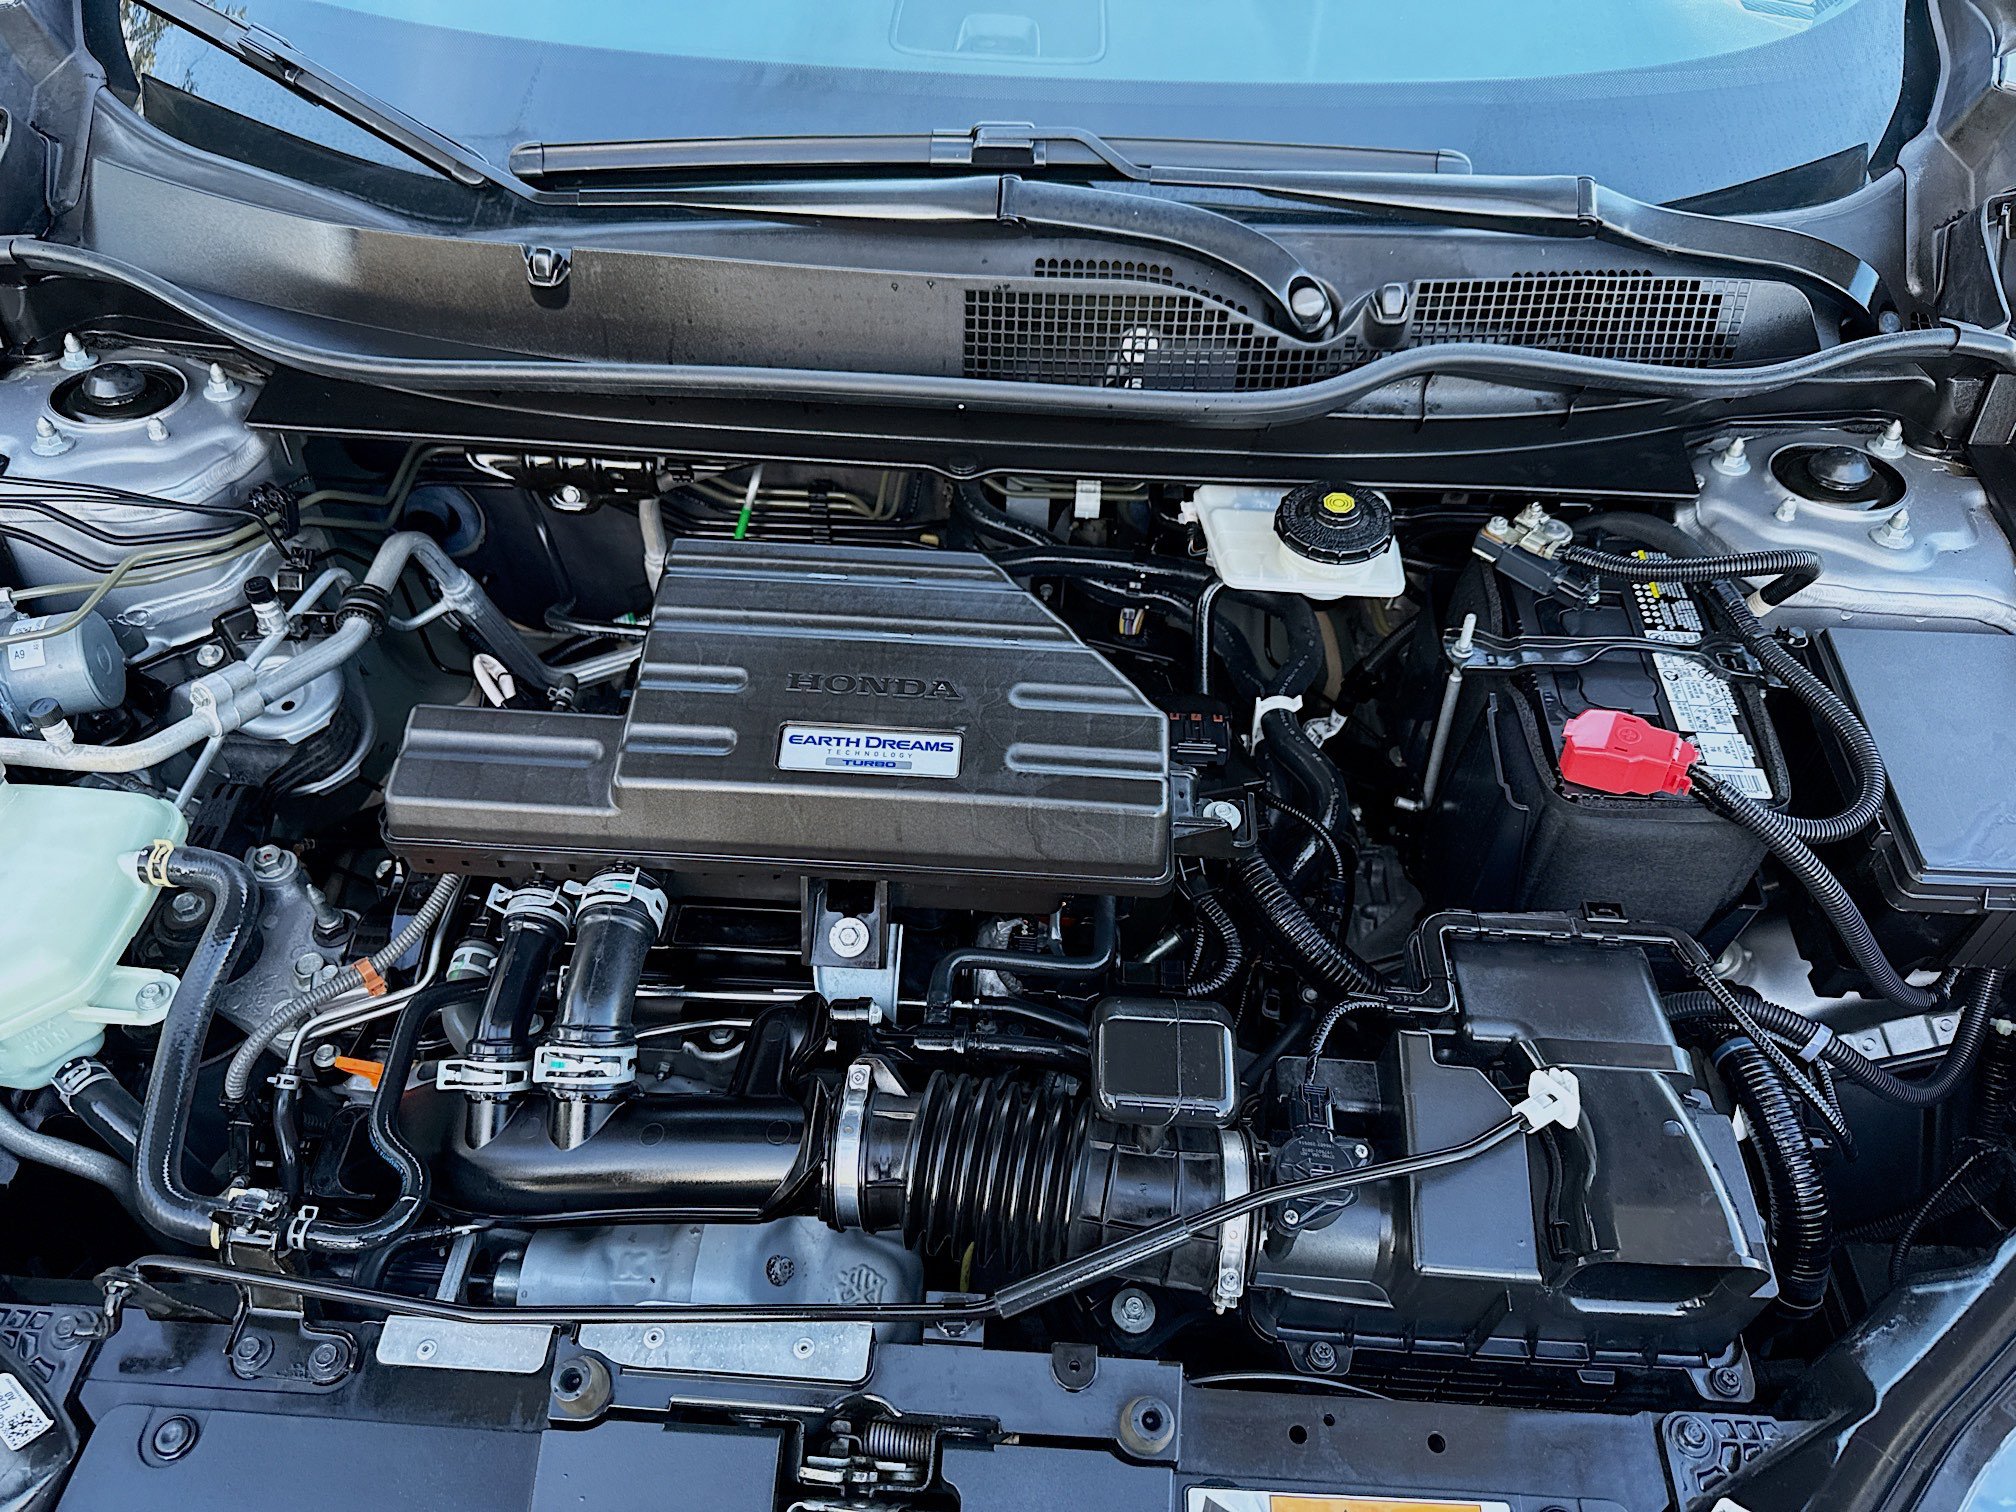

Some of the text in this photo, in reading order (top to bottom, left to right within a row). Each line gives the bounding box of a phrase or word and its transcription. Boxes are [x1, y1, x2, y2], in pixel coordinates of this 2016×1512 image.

[14, 649, 25, 659] A9
[785, 672, 964, 700] HONDA
[788, 734, 954, 752] EARTH DREAMS
[827, 749, 913, 759] TECHNOLOGY
[842, 759, 897, 768] TURBO
[24, 1028, 71, 1056] MIN
